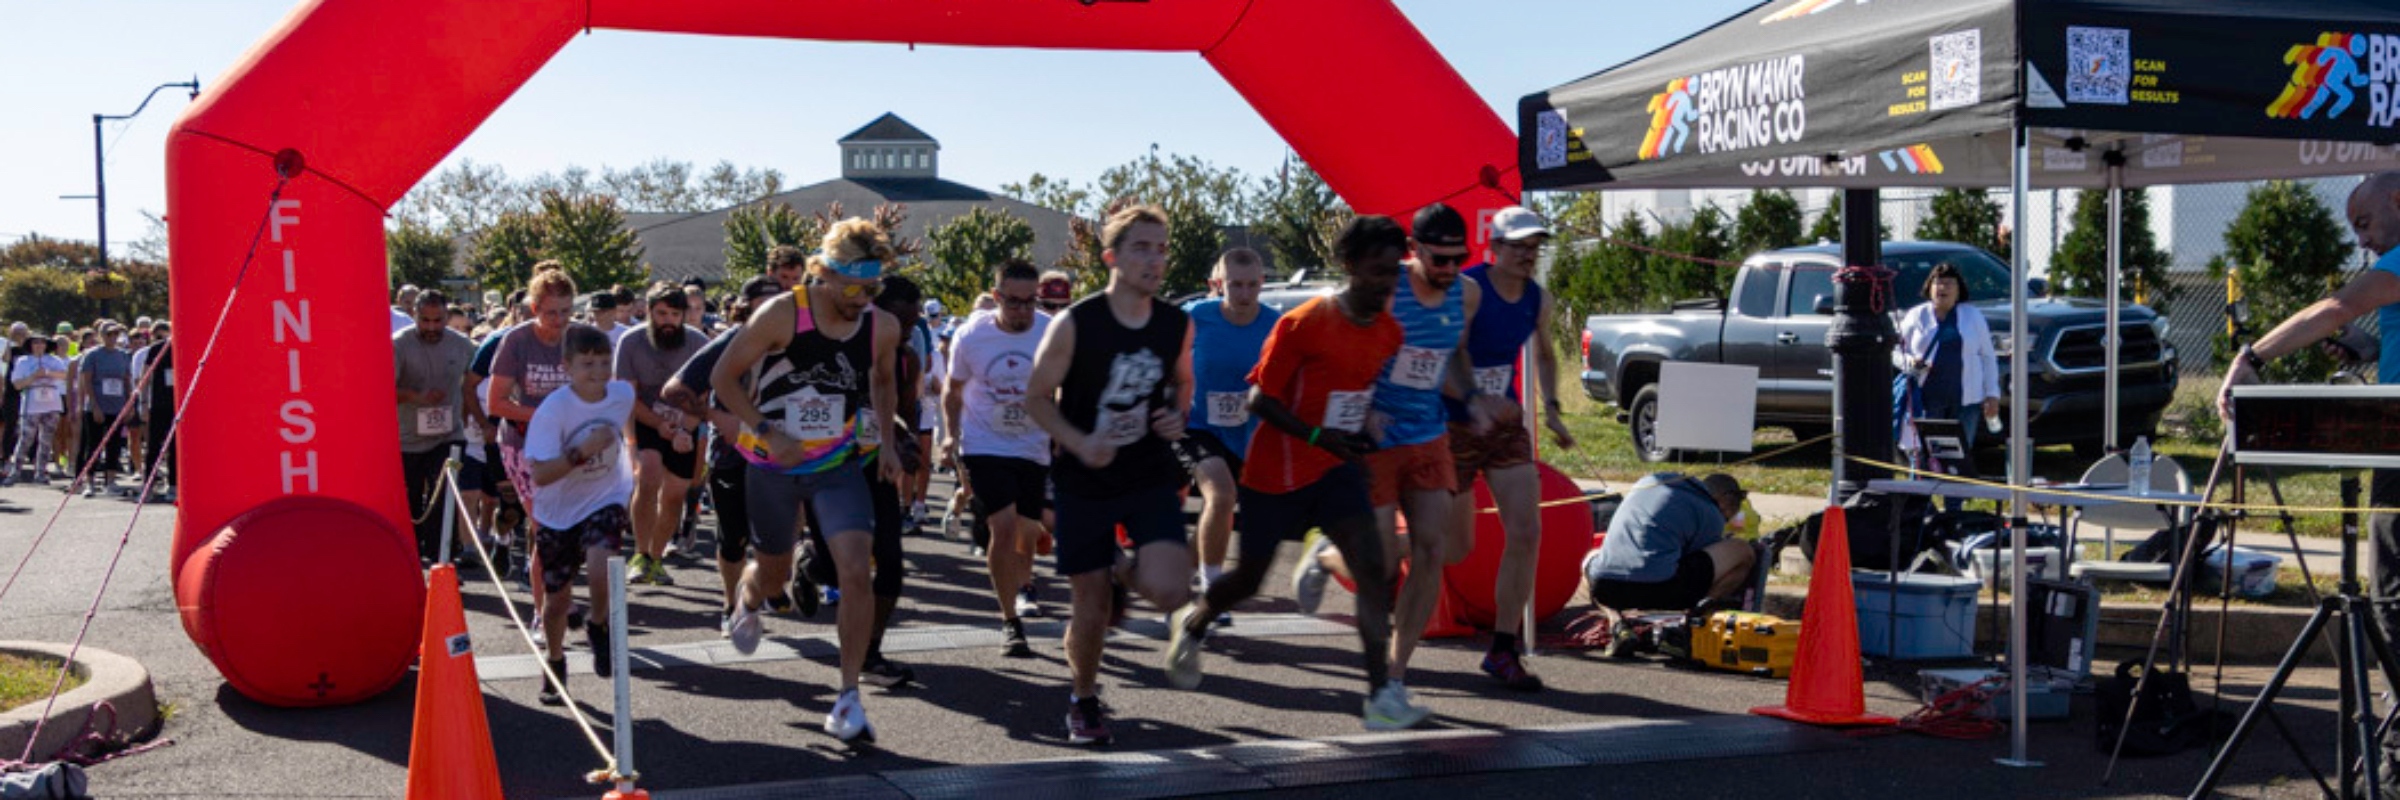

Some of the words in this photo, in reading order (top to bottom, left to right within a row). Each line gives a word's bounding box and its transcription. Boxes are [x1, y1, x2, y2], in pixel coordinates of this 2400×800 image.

[2133, 58, 2166, 72] SCAN
[1699, 64, 1746, 113] BRYN
[1747, 54, 1805, 107] MAWR
[1901, 70, 1928, 86] SCAN
[2132, 74, 2159, 87] FOR
[1906, 86, 1927, 99] FOR
[2131, 90, 2180, 103] RESULTS
[1888, 101, 1927, 117] RESULTS
[1699, 104, 1771, 155] RACING
[1774, 98, 1805, 144] CO
[269, 199, 318, 494] FINISH
[800, 407, 831, 422] 295
